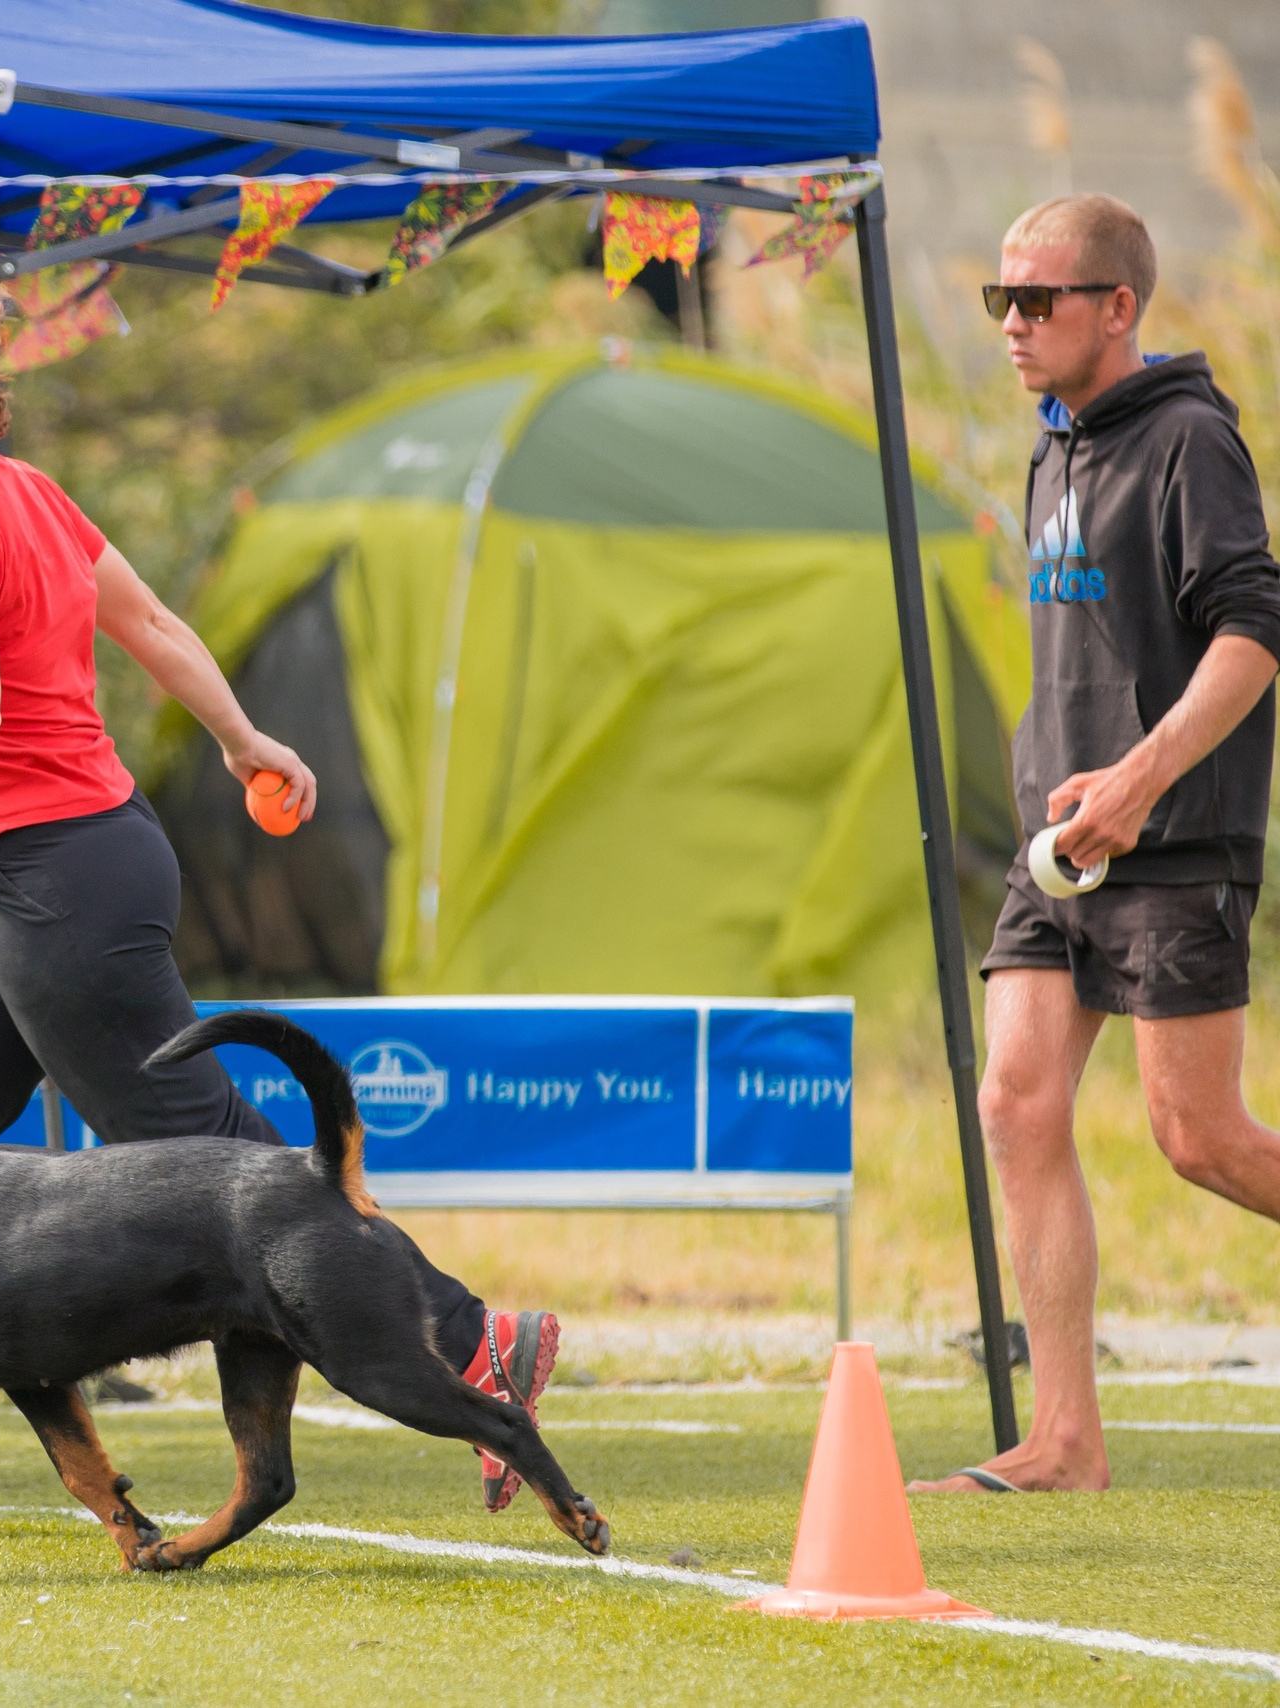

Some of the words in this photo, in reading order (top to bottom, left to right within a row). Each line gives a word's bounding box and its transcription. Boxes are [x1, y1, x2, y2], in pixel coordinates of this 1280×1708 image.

[465, 1069, 583, 1111] Happy
[737, 1067, 852, 1109] Happy
[487, 1310, 502, 1375] SALOMON
